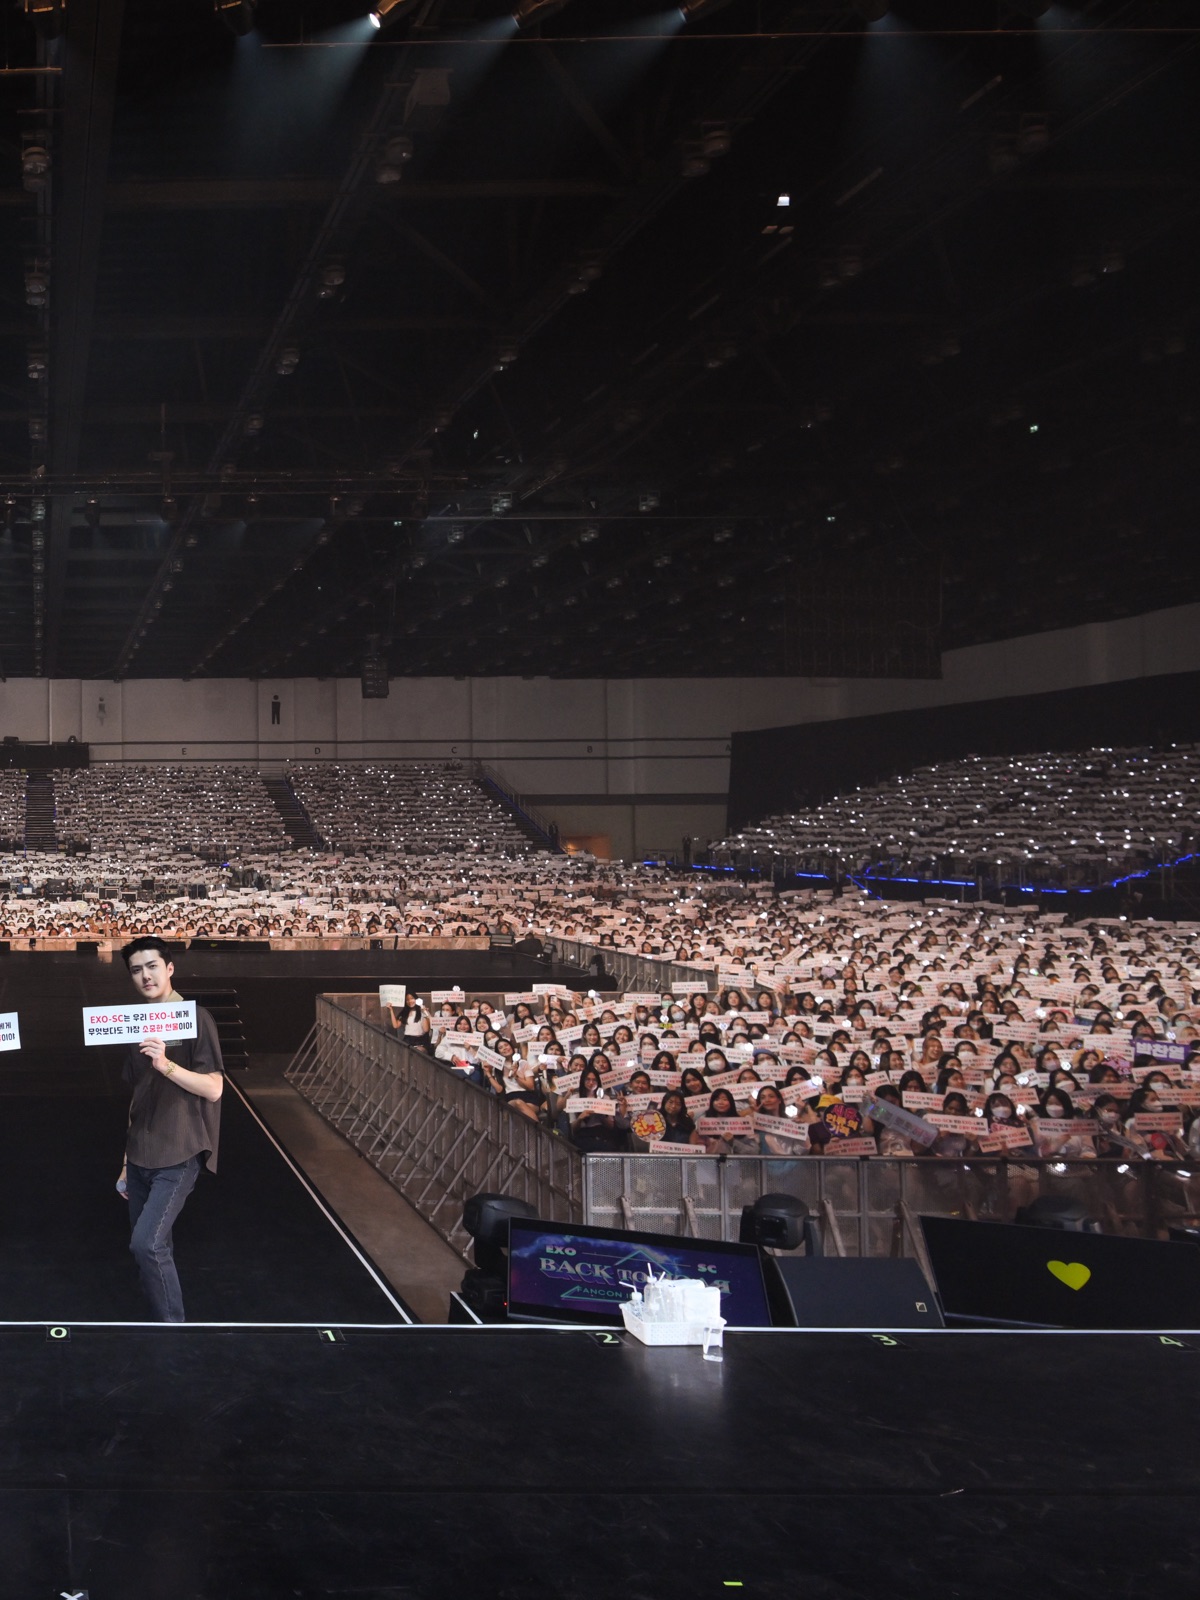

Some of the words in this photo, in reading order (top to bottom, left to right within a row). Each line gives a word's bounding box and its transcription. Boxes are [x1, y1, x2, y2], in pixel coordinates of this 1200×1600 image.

[90, 1014, 131, 1024] EXO-SC는
[133, 1013, 147, 1022] 우리
[149, 1010, 190, 1020] EXO-L에게
[88, 1026, 123, 1036] 무엇보다도
[126, 1025, 140, 1034] 가장
[142, 1024, 163, 1033] 소중한
[545, 1245, 577, 1256] EXO
[697, 1263, 717, 1274] SC
[539, 1257, 613, 1279] BACK
[617, 1268, 648, 1283] TO
[576, 1287, 623, 1299] FANCON
[50, 1327, 67, 1338] 0
[322, 1330, 336, 1342] 1
[596, 1332, 619, 1344] 2
[872, 1334, 898, 1346] 3
[1159, 1336, 1185, 1347] 4
